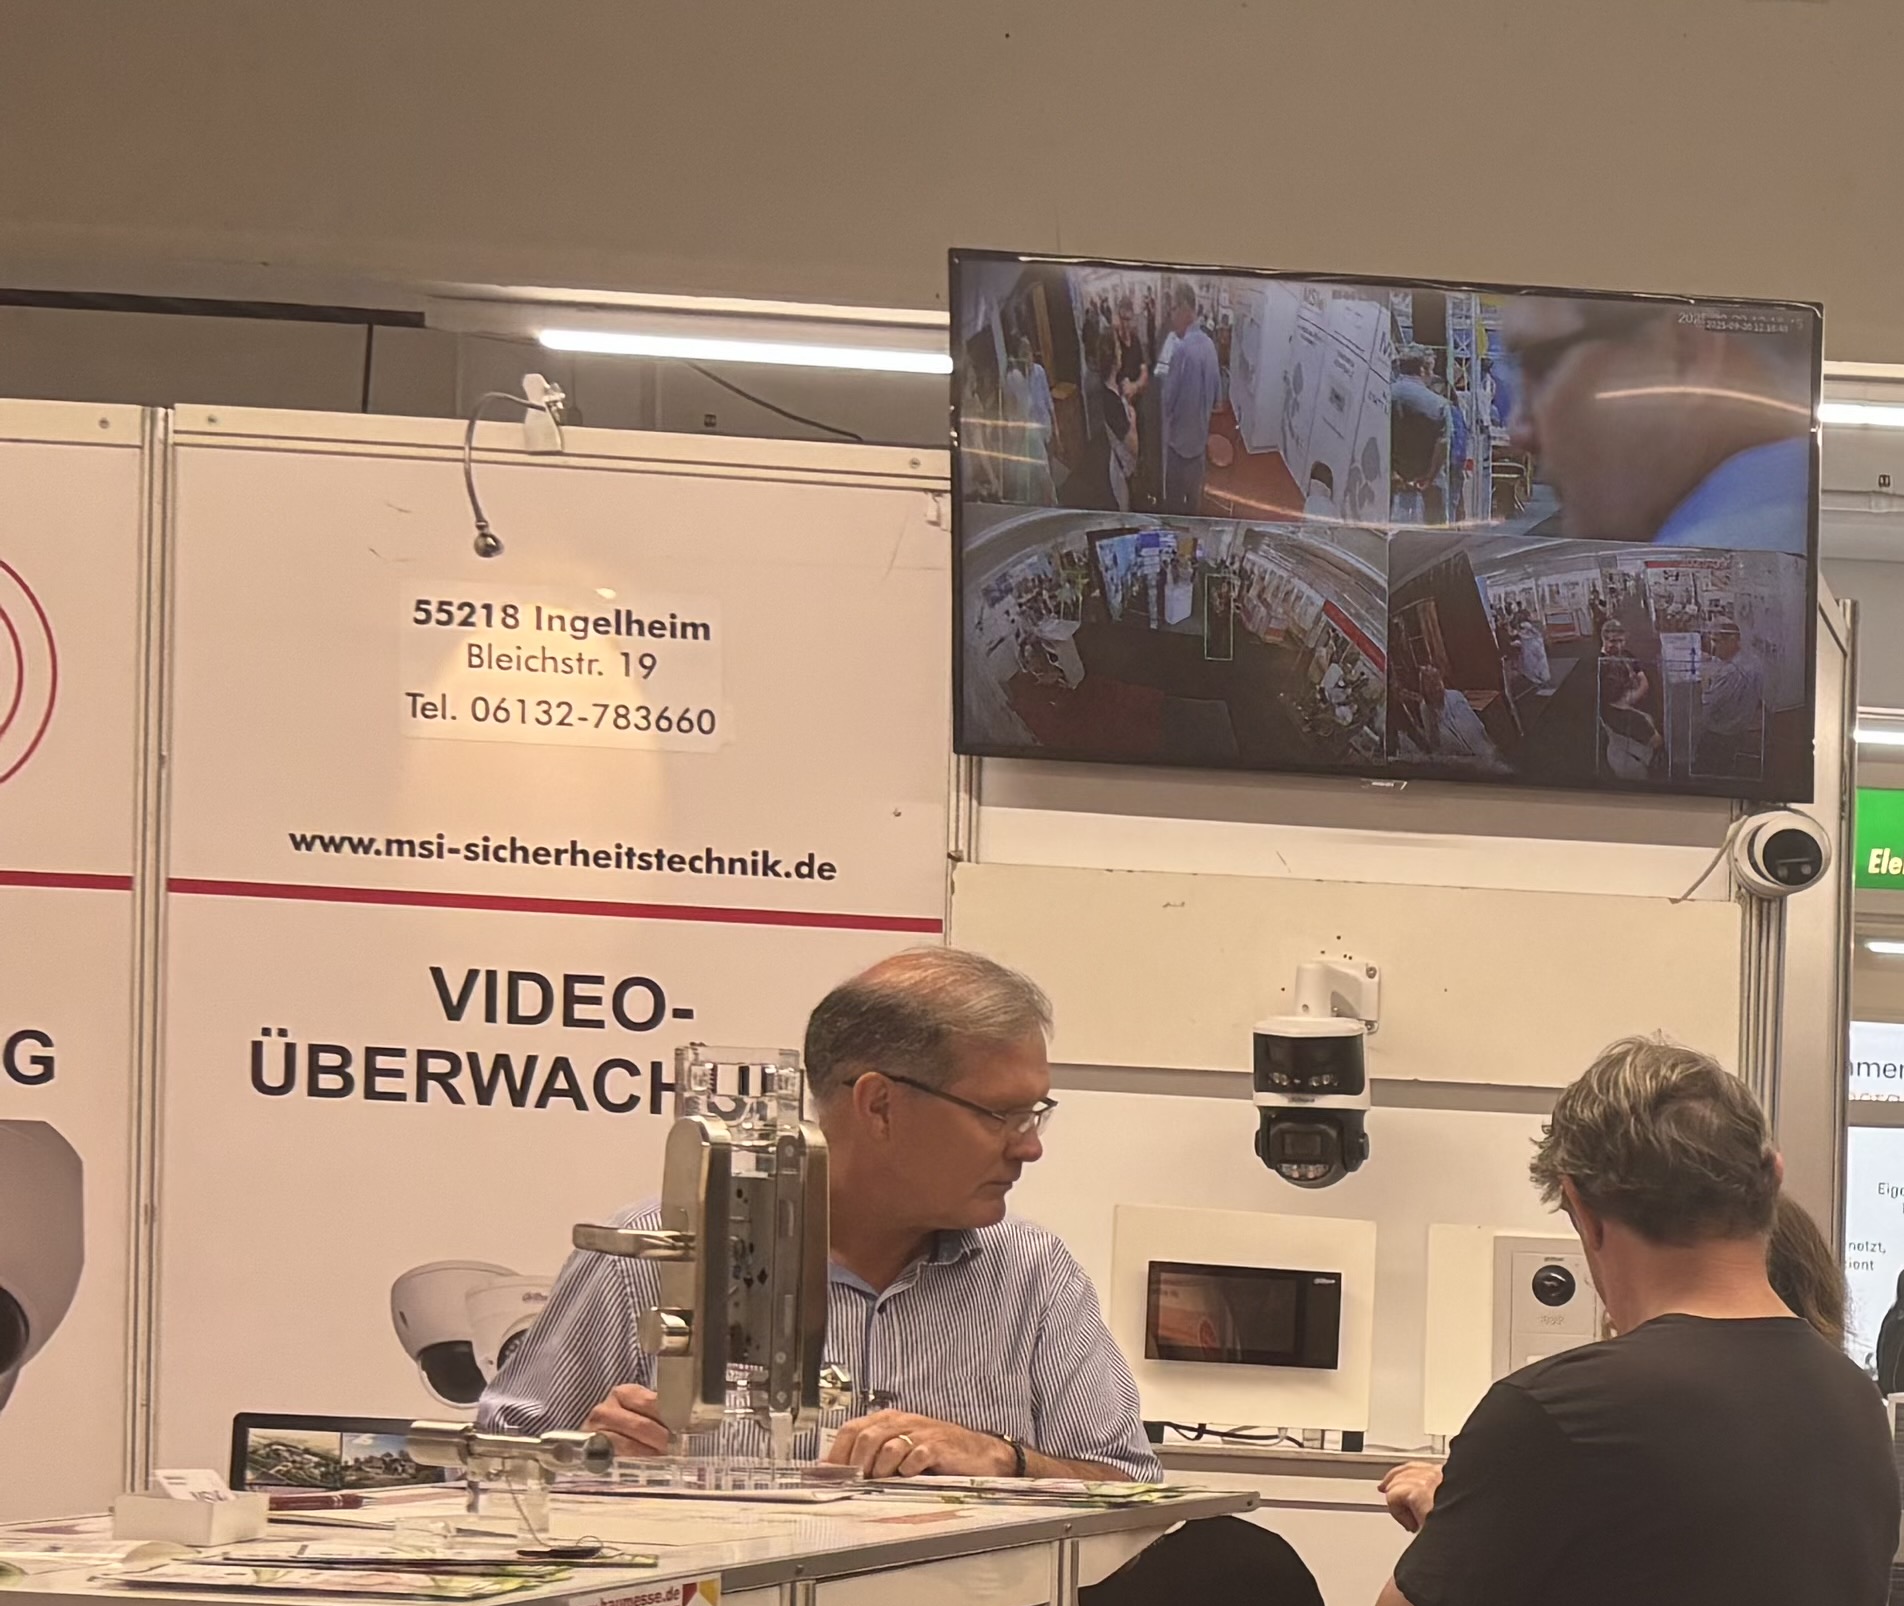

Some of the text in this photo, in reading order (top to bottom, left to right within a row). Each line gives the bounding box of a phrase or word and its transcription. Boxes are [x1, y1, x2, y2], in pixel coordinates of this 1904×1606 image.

[412, 598, 711, 641] 55218 Ingelheim
[467, 643, 657, 679] Bleichstr. 19
[405, 692, 716, 735] Tel. 06132-783660
[288, 832, 838, 881] www.msi-sicherheitstechnik.de
[429, 965, 696, 1032] VIDEO-
[3, 1029, 55, 1085] G
